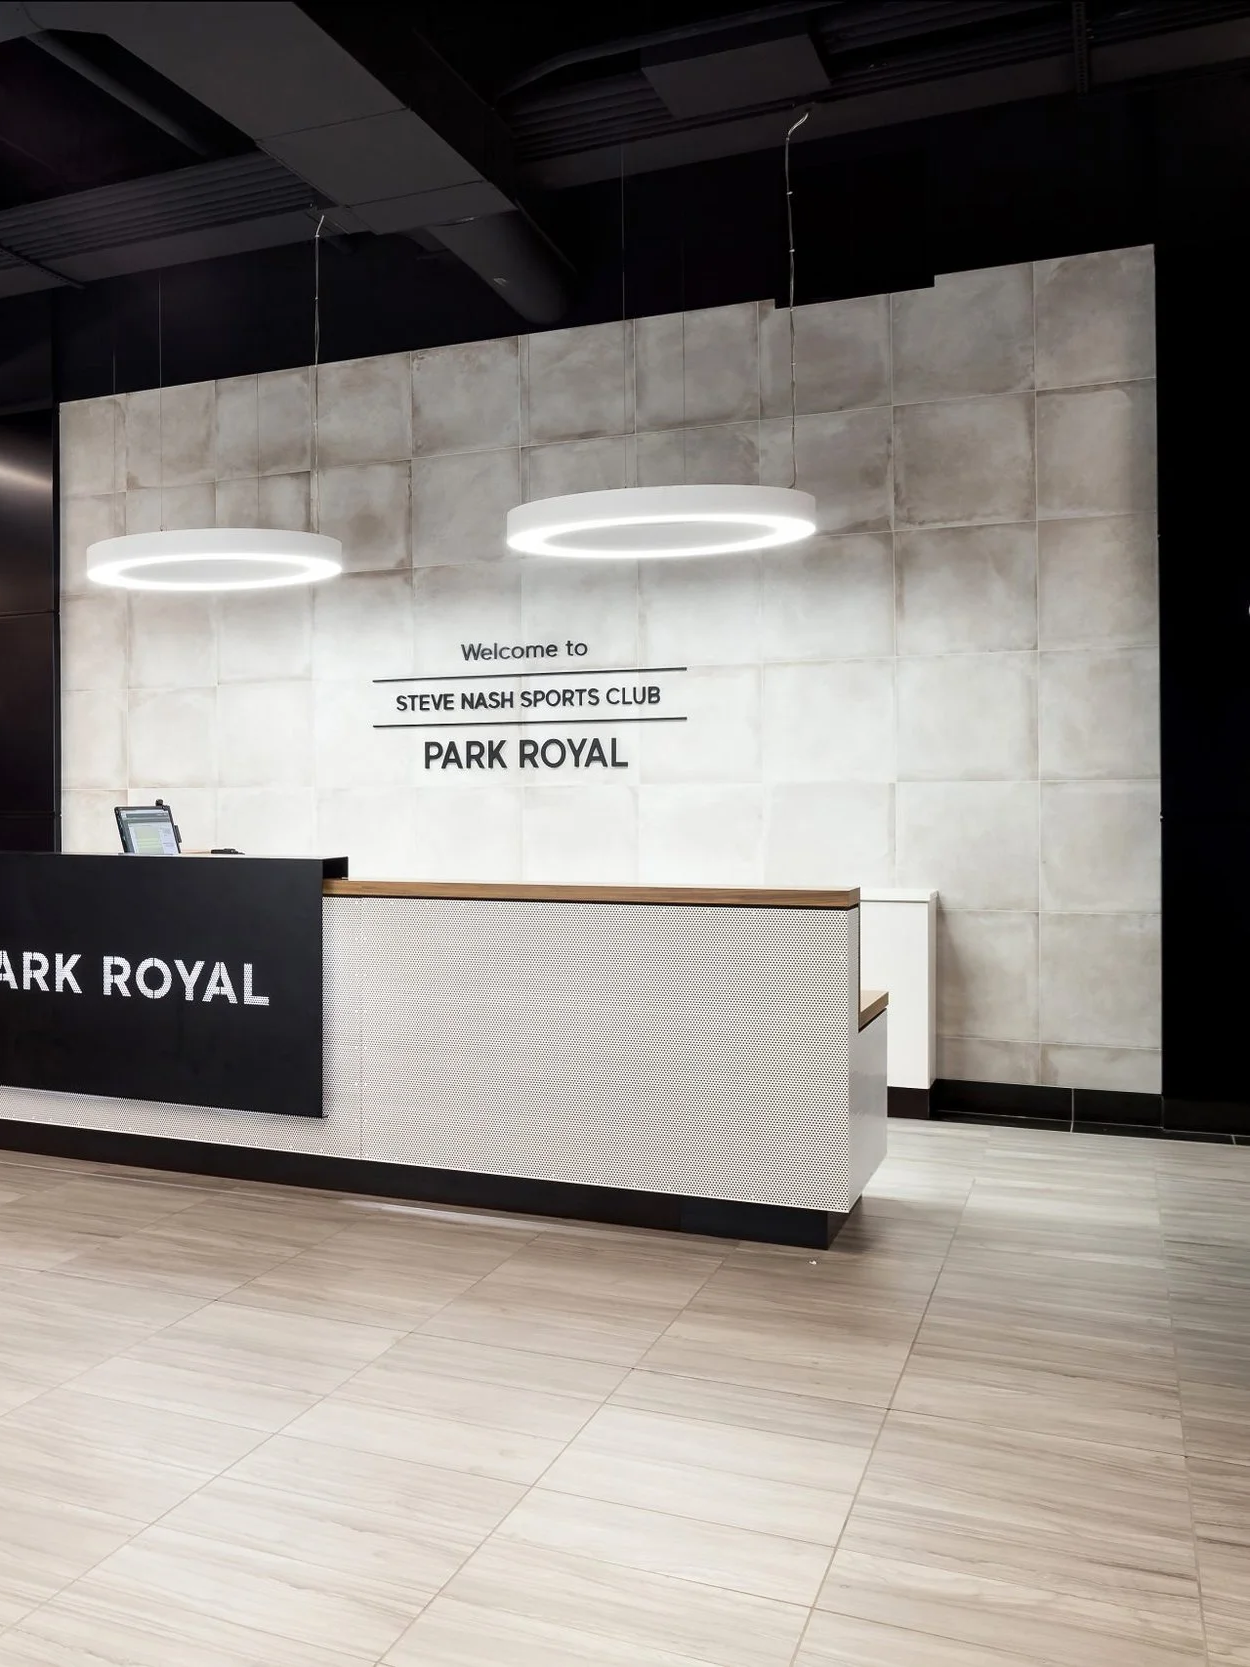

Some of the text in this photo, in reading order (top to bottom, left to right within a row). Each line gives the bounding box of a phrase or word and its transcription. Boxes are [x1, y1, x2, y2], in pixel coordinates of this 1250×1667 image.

[461, 640, 588, 661] Welcome to
[396, 686, 661, 712] STEVE NASH SPORTS CLUB
[424, 738, 629, 770] PARK ROYAL
[102, 955, 270, 1006] ROYAL
